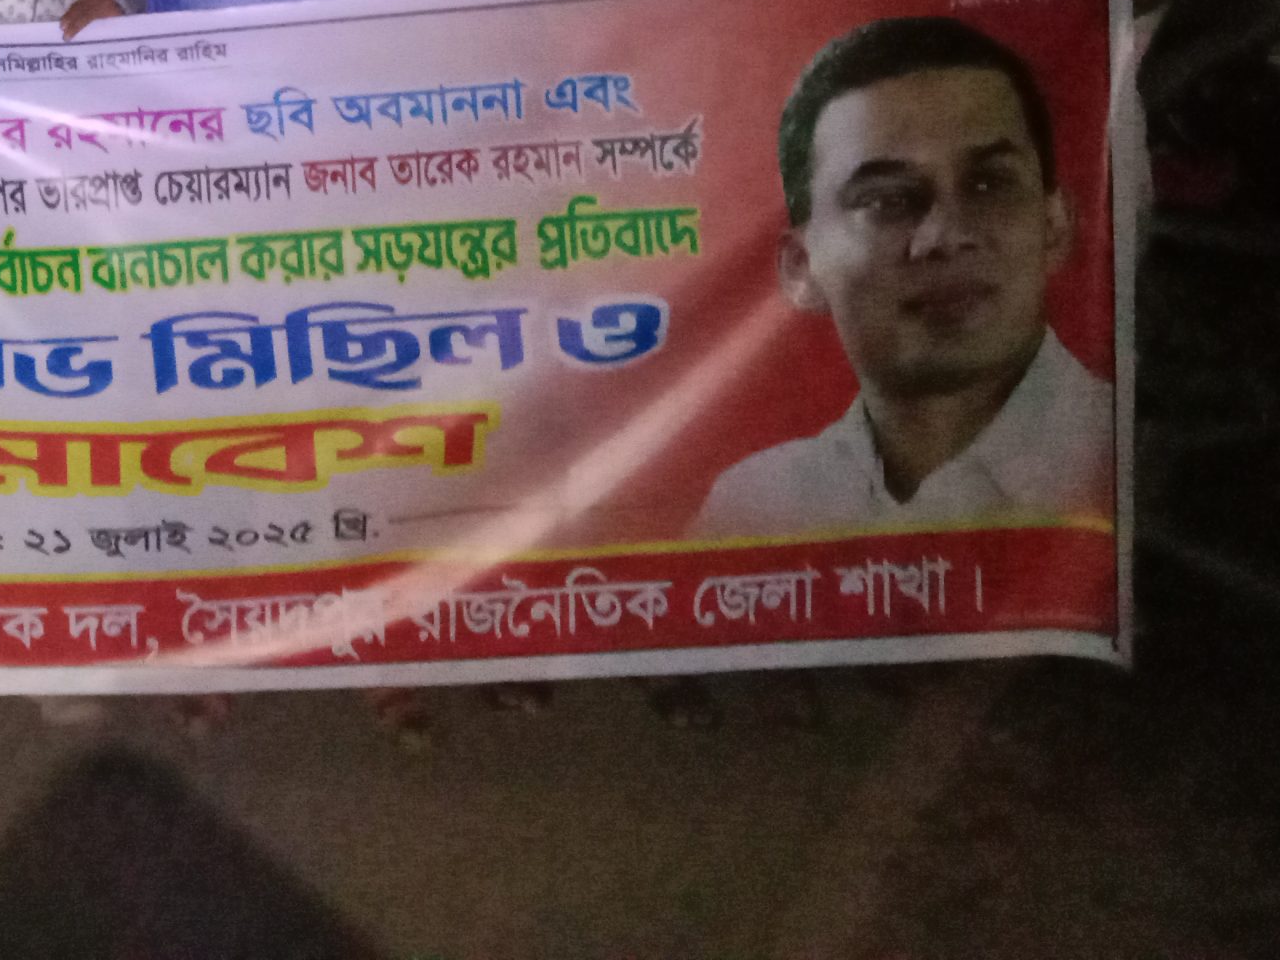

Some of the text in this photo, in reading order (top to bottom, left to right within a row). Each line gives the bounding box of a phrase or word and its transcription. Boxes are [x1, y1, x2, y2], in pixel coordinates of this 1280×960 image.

[240, 86, 317, 139] ছবি
[332, 76, 524, 130] অবমাননা
[544, 74, 639, 114] এবং
[35, 169, 143, 212] ভারপ্রাপ্ত
[154, 163, 292, 206] চেয়ারম্যান
[302, 155, 378, 196] জনাব
[388, 147, 481, 190] তারেক
[491, 139, 581, 181] রহমান
[592, 117, 700, 174] সম্পর্কে
[87, 238, 230, 292] বানচাল
[235, 230, 347, 285] করার
[537, 194, 700, 271] প্রতিবাদে
[140, 300, 528, 395] মিছিল
[557, 297, 668, 365] ও
[23, 527, 73, 555] ২১
[88, 518, 192, 558] জুলাই
[207, 521, 316, 553] ২০২৫
[408, 566, 673, 643] রাজনৈতিক
[692, 562, 822, 625] জেলা
[835, 553, 953, 618] শাখা
